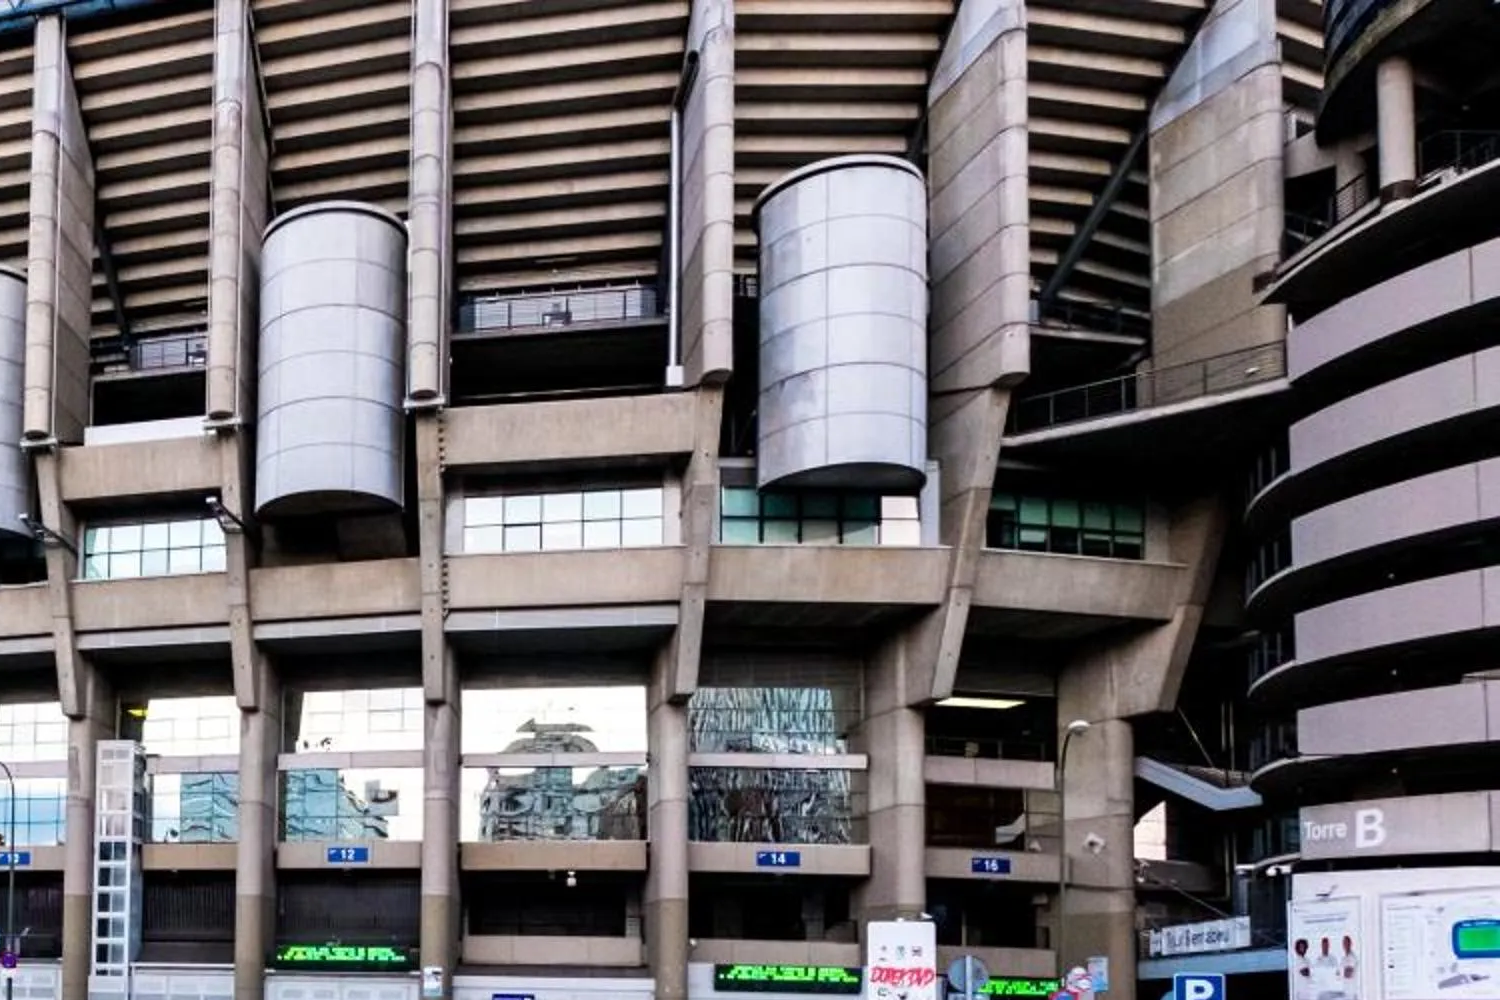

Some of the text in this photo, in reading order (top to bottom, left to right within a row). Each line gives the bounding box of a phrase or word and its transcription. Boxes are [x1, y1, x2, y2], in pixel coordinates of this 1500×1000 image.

[1303, 807, 1386, 849] Torre B
[340, 849, 356, 861] 12
[771, 853, 786, 864] 14
